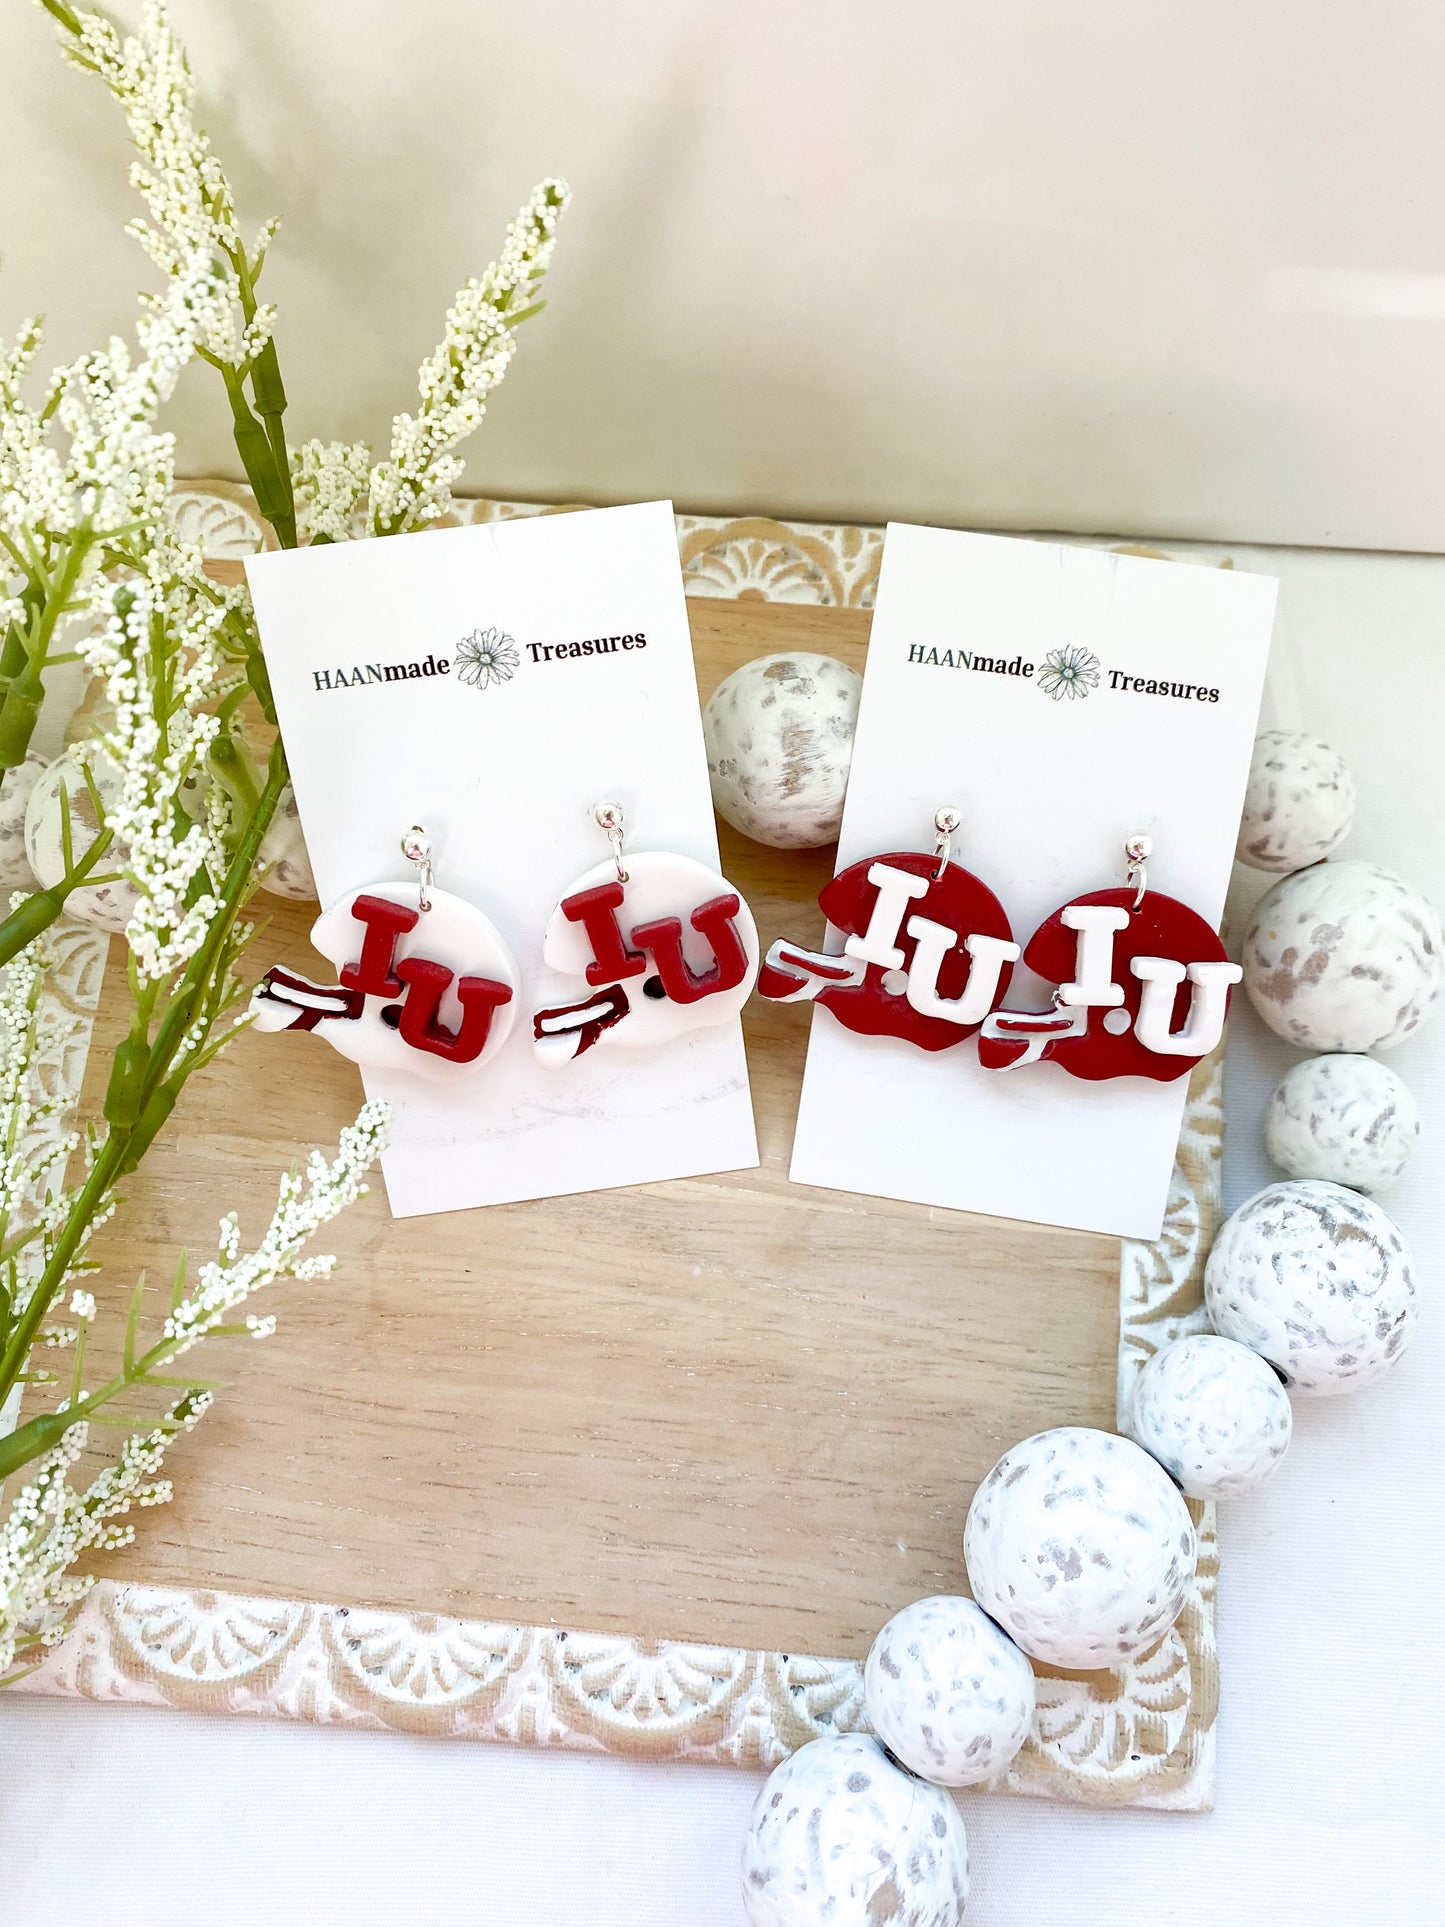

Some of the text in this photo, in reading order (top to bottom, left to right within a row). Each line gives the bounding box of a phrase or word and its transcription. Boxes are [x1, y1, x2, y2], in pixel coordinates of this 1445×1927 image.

[313, 632, 647, 691] HAANmade Treasures
[907, 644, 1220, 703] HAANmade Treasures
[339, 894, 514, 1064] IU
[561, 881, 750, 1005] IU
[845, 862, 1021, 1025] IU
[1058, 905, 1243, 1057] IU
